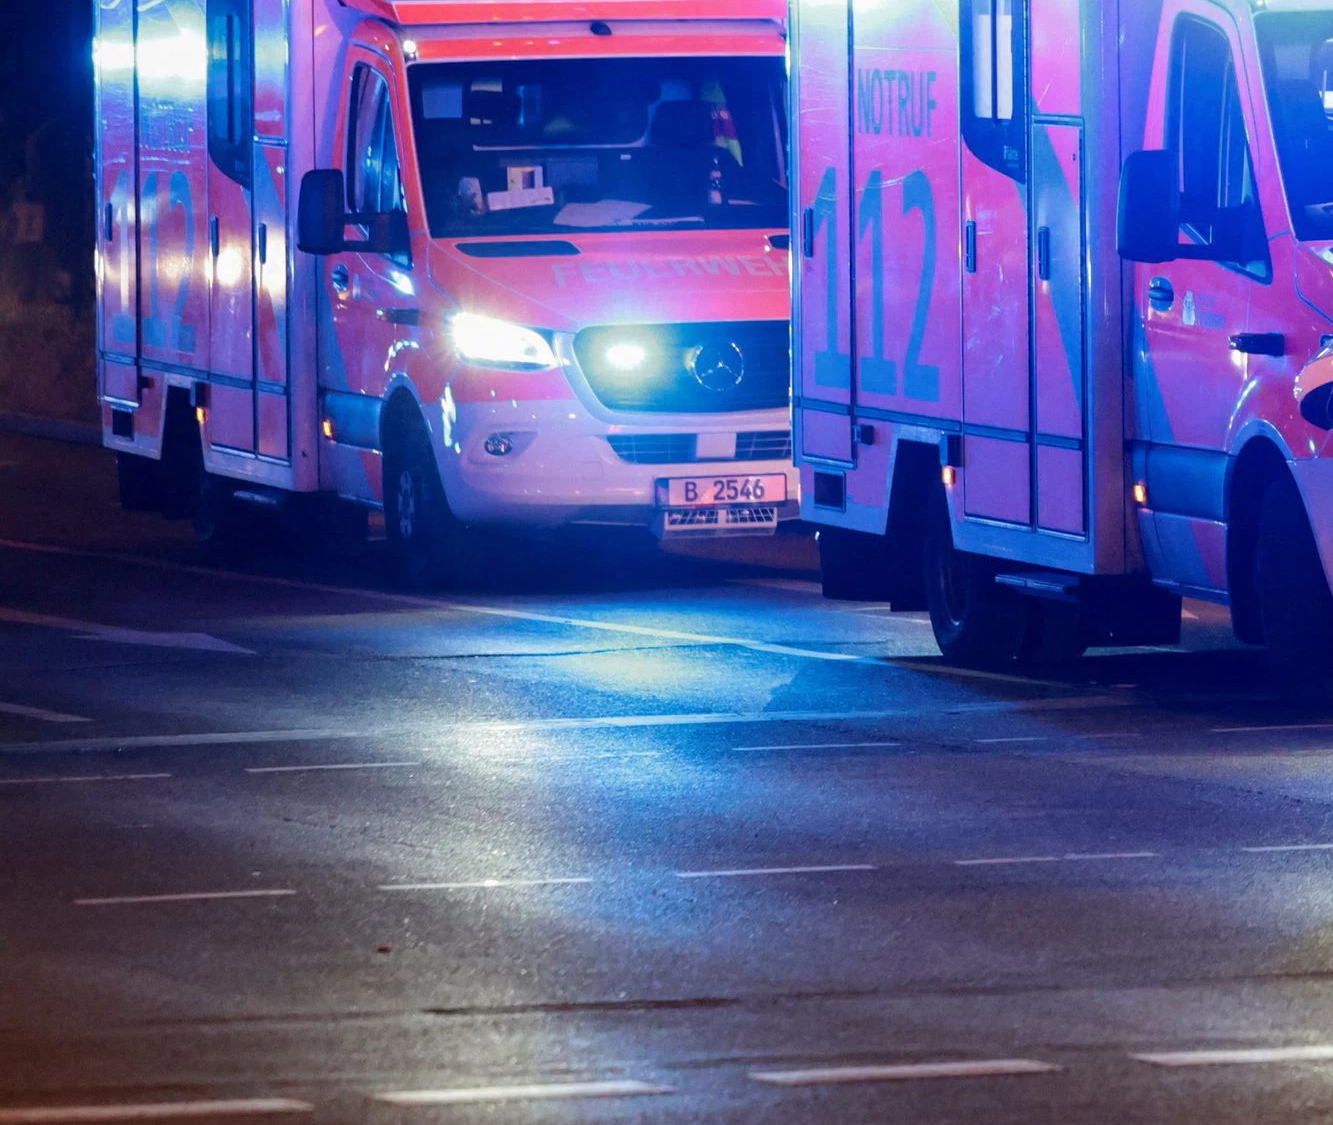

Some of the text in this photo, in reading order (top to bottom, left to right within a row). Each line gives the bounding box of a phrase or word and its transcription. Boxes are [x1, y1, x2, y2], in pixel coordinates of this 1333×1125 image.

[857, 67, 937, 138] NOTRUF
[813, 166, 940, 402] 112
[684, 478, 765, 503] B 2546
